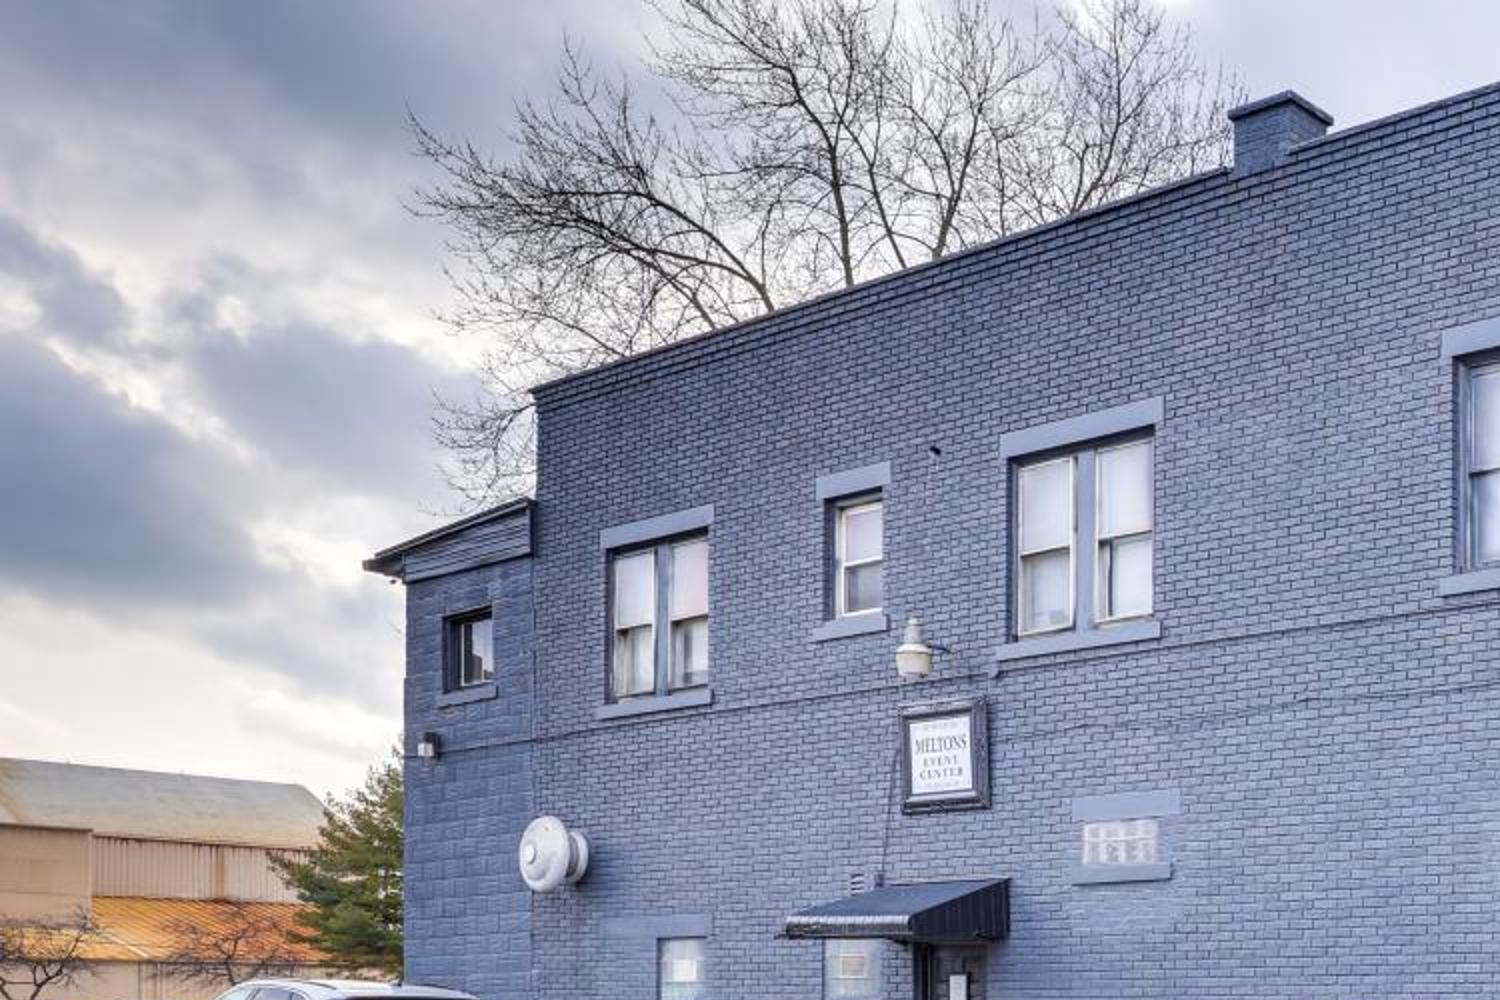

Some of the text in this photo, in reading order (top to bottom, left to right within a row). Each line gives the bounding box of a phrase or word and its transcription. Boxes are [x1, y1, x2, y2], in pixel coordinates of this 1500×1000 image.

[915, 734, 967, 754] MELTONS
[923, 755, 958, 768] EVENT
[919, 767, 963, 780] CENTER
